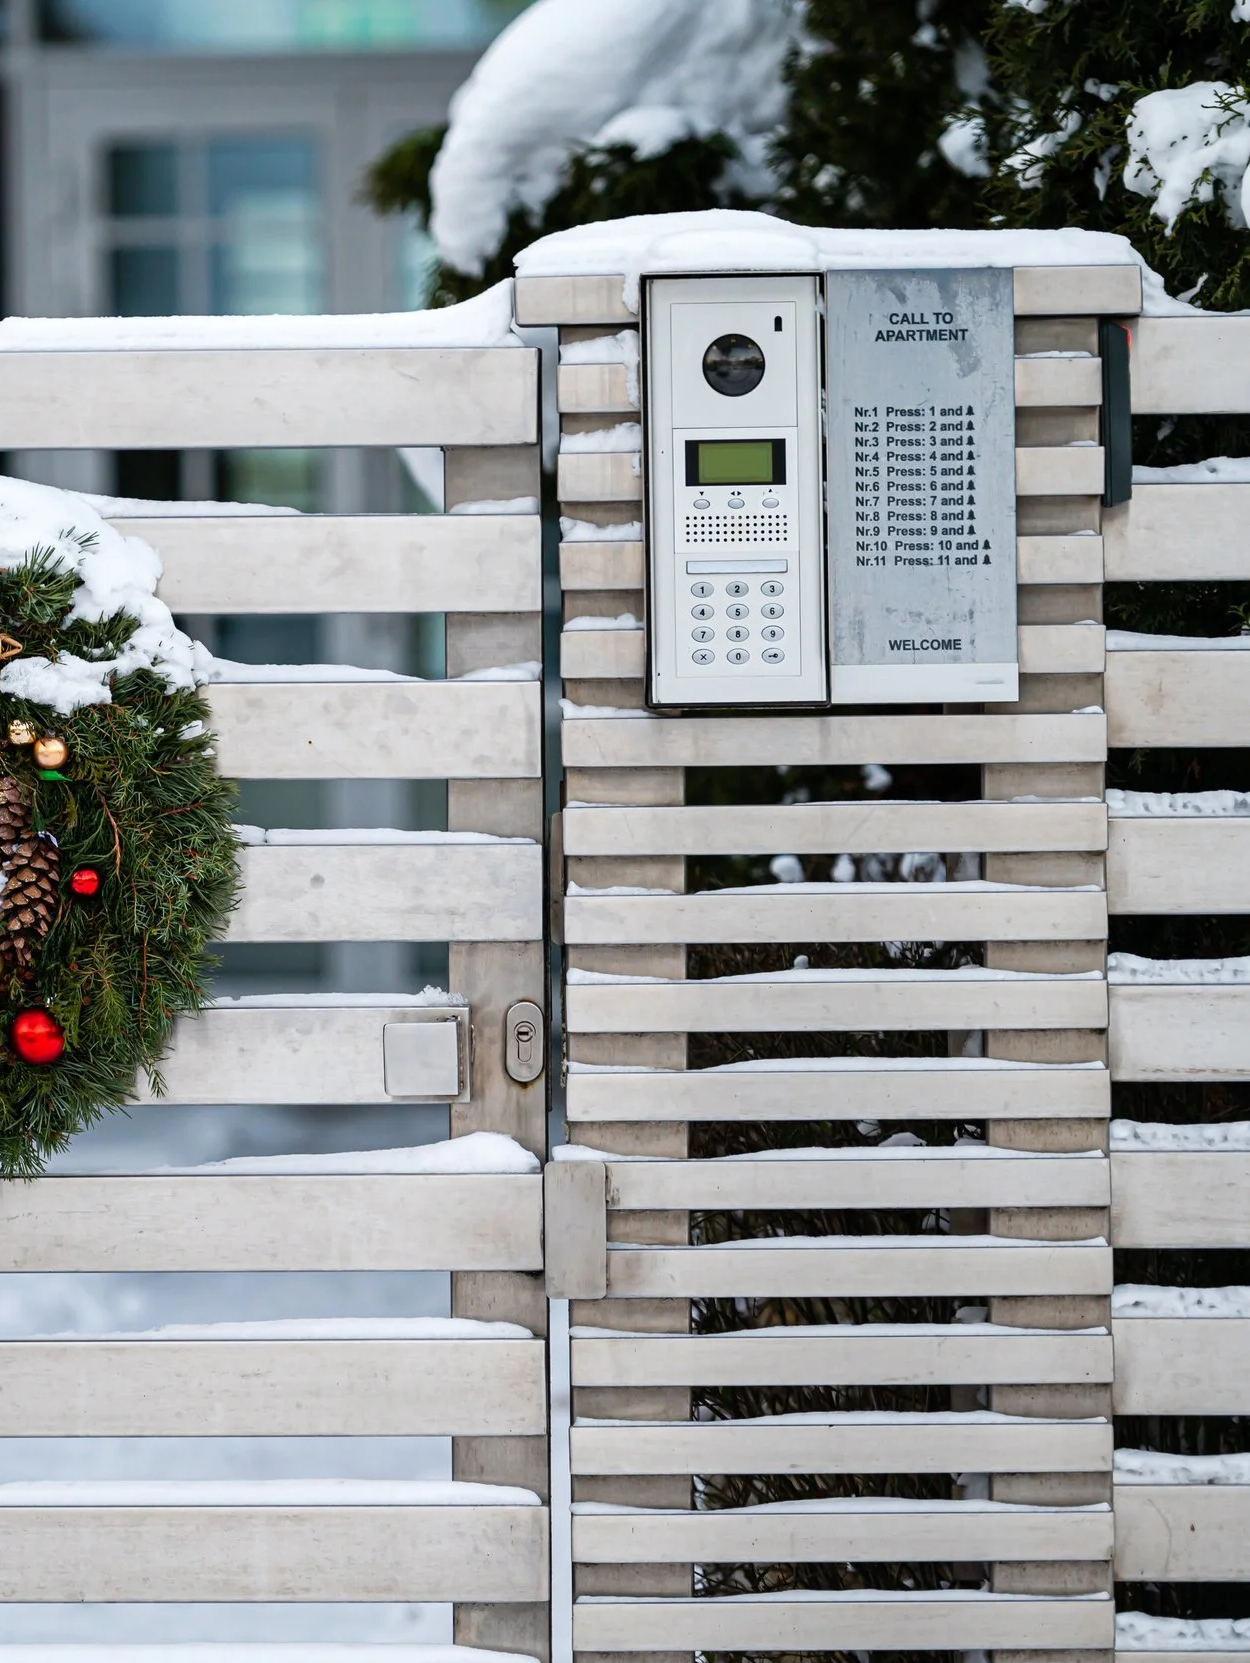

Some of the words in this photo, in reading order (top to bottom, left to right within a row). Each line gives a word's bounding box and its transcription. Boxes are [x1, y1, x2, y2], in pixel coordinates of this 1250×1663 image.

[889, 313, 929, 325] CALL
[933, 312, 953, 324] TO
[875, 329, 968, 342] APARTMENT
[855, 407, 878, 417] Nr.1
[886, 407, 925, 417] Press:
[929, 406, 936, 417] 1
[940, 406, 962, 416] and
[855, 422, 880, 432] Nr.2
[887, 422, 925, 432] Press:
[928, 421, 937, 432] 2
[940, 421, 963, 431] and
[855, 437, 880, 447] Nr.3
[887, 436, 925, 447] Press:
[929, 436, 937, 447] 3
[940, 436, 963, 446] and
[855, 452, 880, 462] Nr.4
[887, 452, 925, 461] Press:
[929, 451, 938, 462] 4
[940, 450, 963, 461] and
[856, 467, 880, 477] Nr.5
[887, 466, 925, 476] Press:
[929, 466, 938, 477] 5
[941, 465, 963, 476] and
[856, 482, 880, 491] Nr.6
[887, 481, 926, 491] Press:
[929, 481, 938, 492] 6
[941, 480, 963, 491] and
[856, 497, 880, 506] Nr.7
[888, 496, 926, 506] Press:
[929, 496, 938, 507] 7
[941, 495, 963, 505] and
[856, 511, 881, 521] Nr.8
[888, 511, 926, 521] Press:
[930, 511, 938, 522] 8
[941, 510, 964, 521] and
[856, 526, 881, 536] Nr.9
[888, 526, 926, 536] Press:
[929, 526, 938, 536] 9
[942, 525, 964, 535] and
[856, 541, 888, 551] Nr.10
[895, 541, 933, 551] Press:
[938, 540, 953, 550] 10
[956, 540, 978, 550] and
[857, 556, 886, 566] Nr.11
[895, 556, 934, 566] Press:
[938, 555, 950, 565] 11
[955, 555, 977, 565] and
[699, 585, 705, 595] 1
[734, 584, 741, 594] 2
[769, 584, 776, 594] 3
[699, 608, 706, 617] 4
[734, 608, 741, 617] 5
[769, 607, 776, 616] 6
[700, 630, 707, 640] 7
[735, 630, 741, 639] 8
[769, 629, 776, 639] 9
[889, 639, 962, 650] WELCOME
[735, 652, 742, 661] 0
